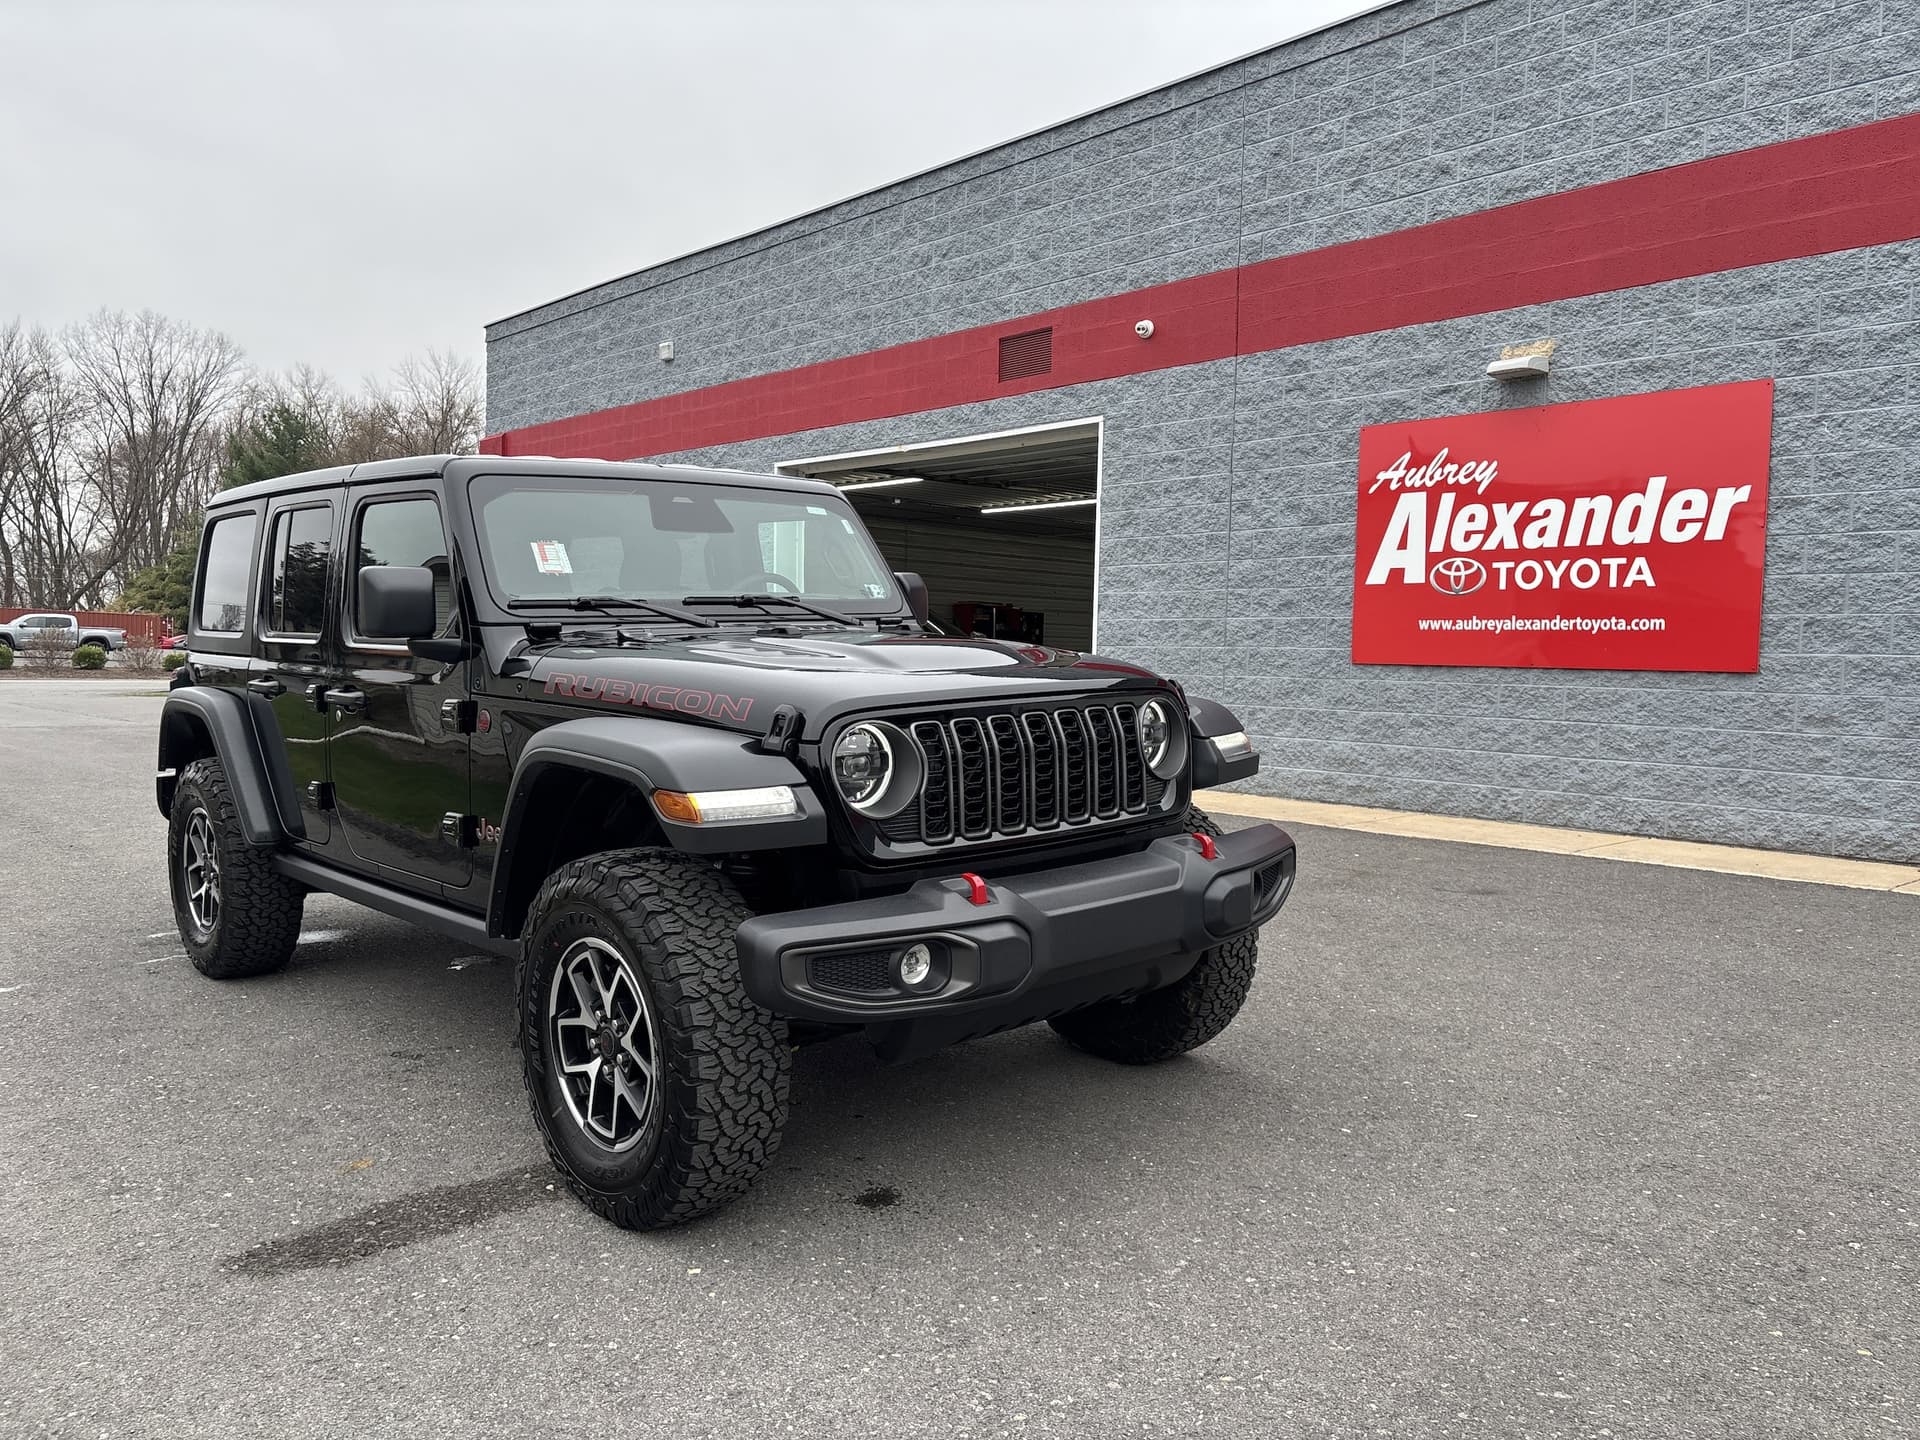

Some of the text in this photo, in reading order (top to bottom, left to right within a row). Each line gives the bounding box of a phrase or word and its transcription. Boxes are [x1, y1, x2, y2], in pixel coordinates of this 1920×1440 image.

[1368, 447, 1498, 494] Aubrey
[1364, 475, 1752, 585] Alexander
[1492, 556, 1656, 590] TOYOTA
[1418, 614, 1666, 635] www.aubreyalexandertoyota.com
[544, 671, 754, 722] RUBICON
[475, 817, 502, 843] Jee
